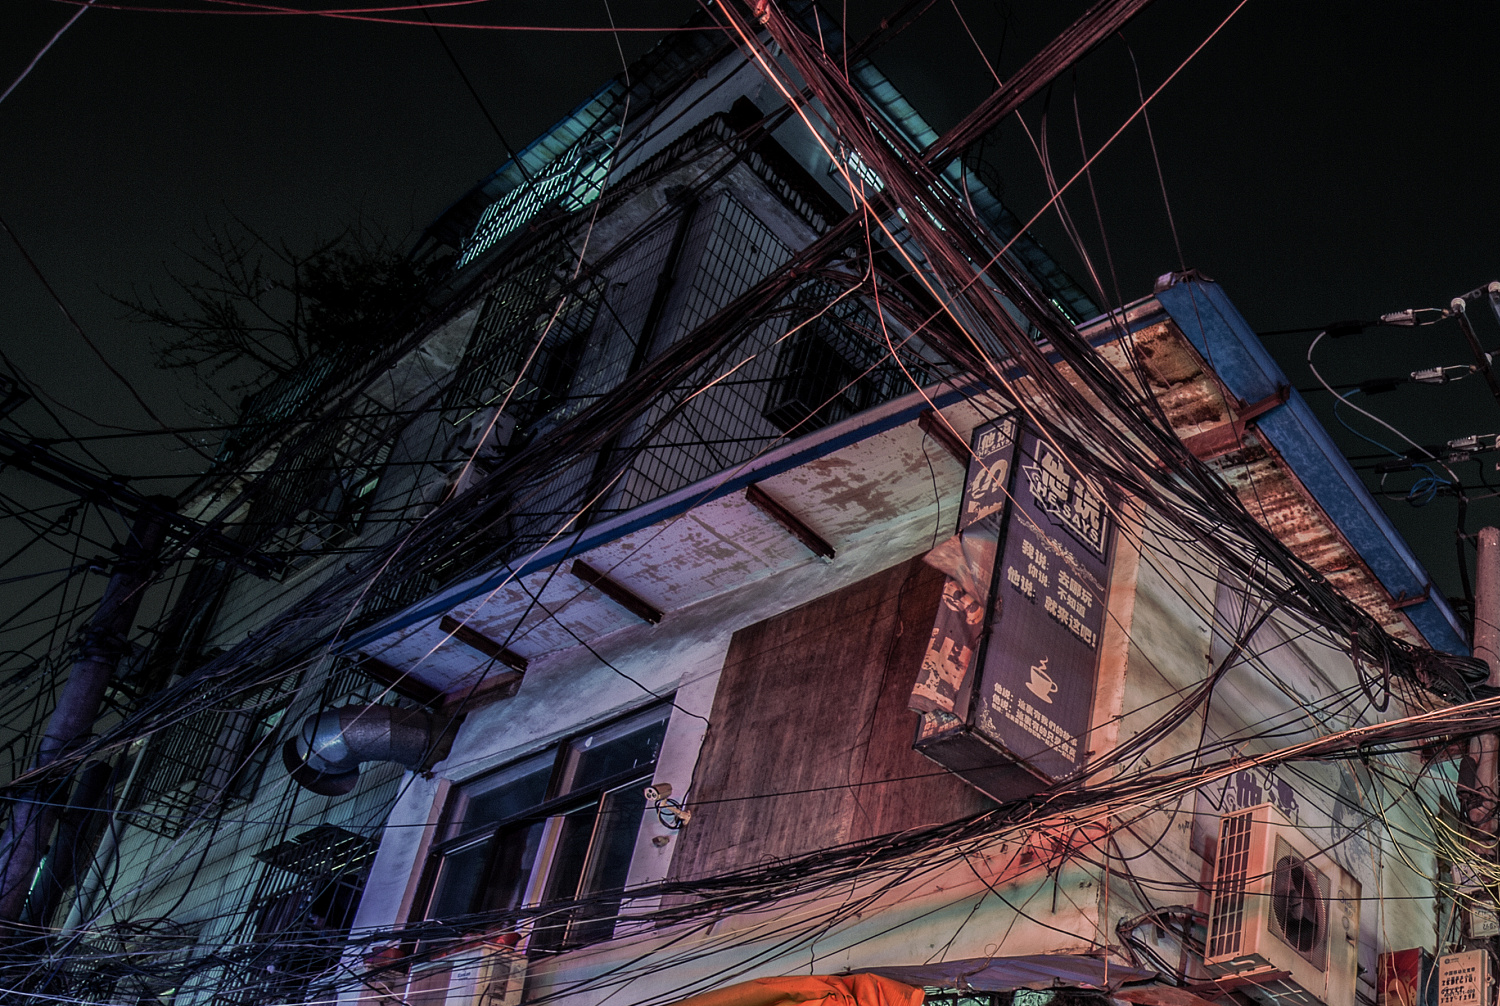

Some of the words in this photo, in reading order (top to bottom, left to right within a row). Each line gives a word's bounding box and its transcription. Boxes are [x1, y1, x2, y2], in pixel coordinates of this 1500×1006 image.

[1062, 504, 1099, 543] SAYS
[1058, 586, 1086, 618] 不知道
